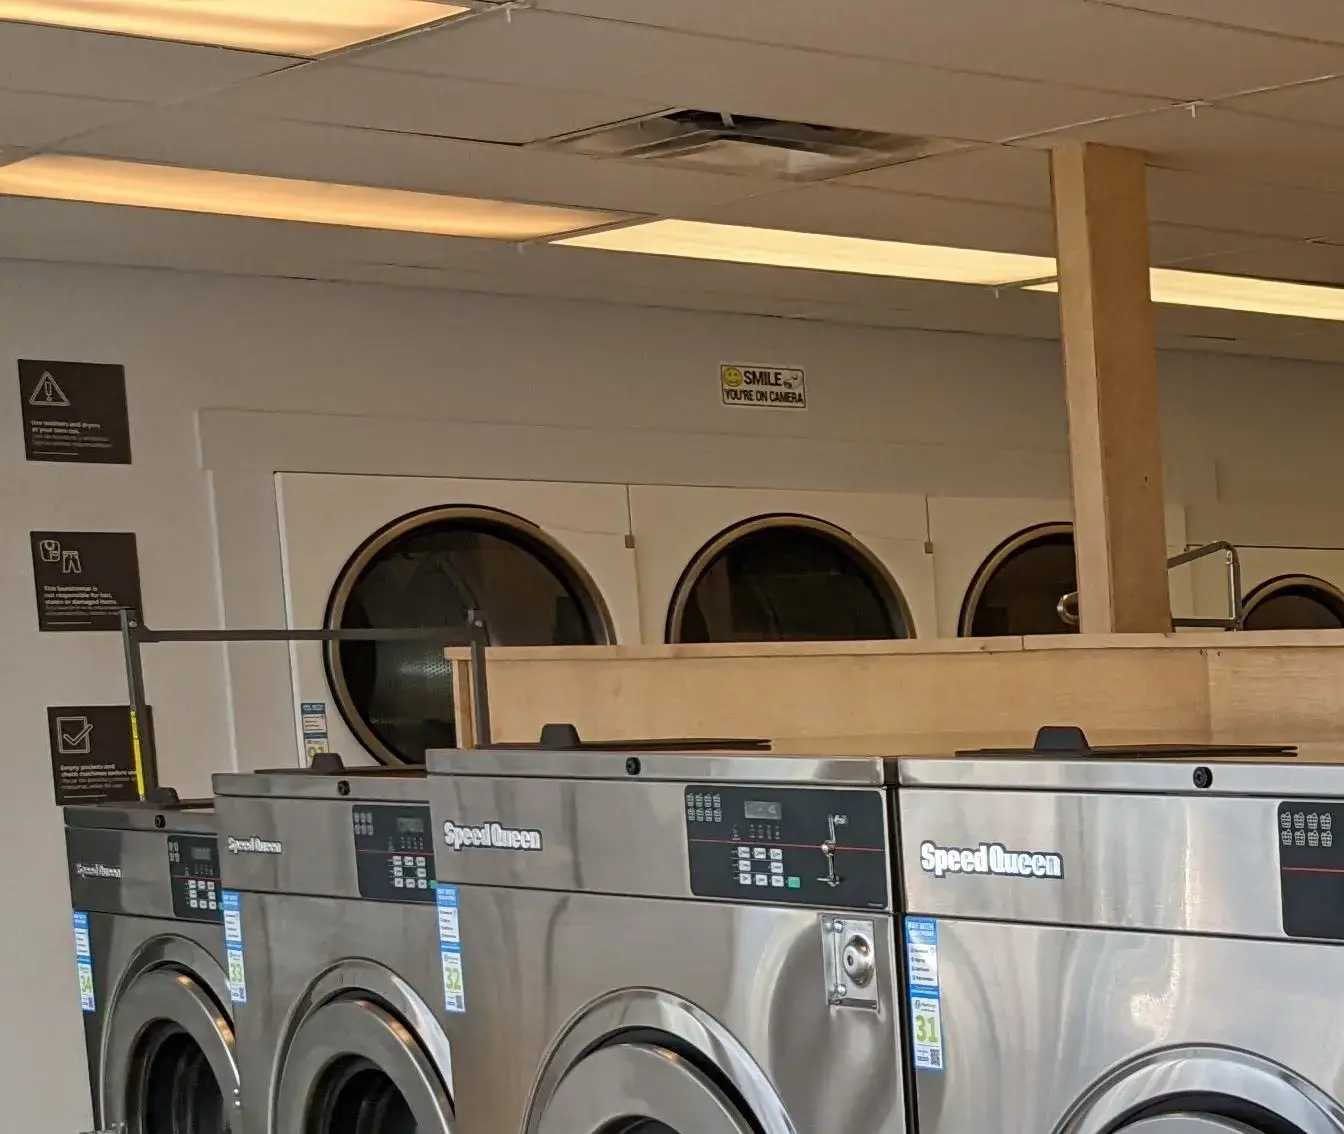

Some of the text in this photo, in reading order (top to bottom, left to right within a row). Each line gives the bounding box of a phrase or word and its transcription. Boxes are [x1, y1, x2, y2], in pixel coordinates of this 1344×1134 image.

[743, 370, 782, 387] SMILE
[724, 388, 803, 404] YOU'RE ON CAMERA
[228, 836, 282, 854] Speed Queen
[444, 820, 541, 850] Speed Queen
[921, 841, 1063, 877] Speed Queen
[445, 967, 461, 990] 32
[915, 1014, 938, 1043] 31
